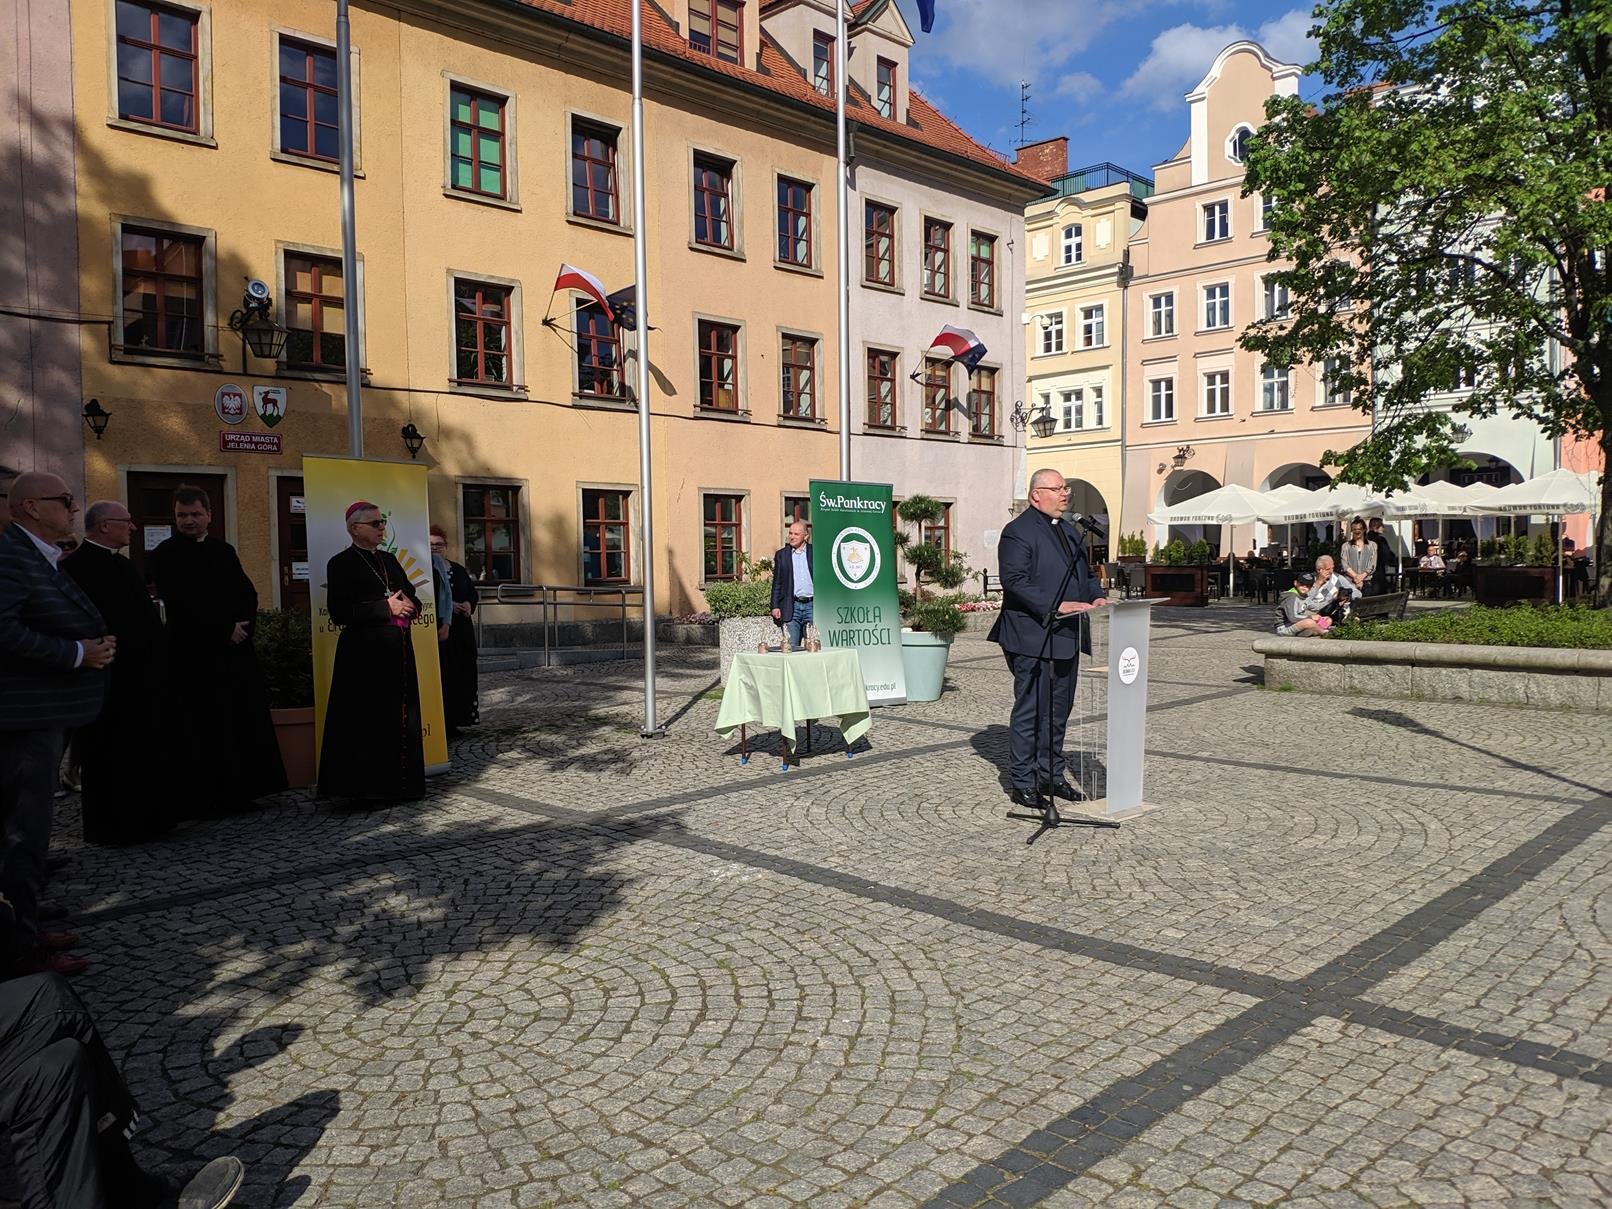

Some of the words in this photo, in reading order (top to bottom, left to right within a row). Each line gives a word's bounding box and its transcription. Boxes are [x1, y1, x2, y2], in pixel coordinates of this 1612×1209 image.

[225, 434, 250, 442] URZĄD
[252, 436, 279, 444] MIASTA
[227, 442, 256, 450] JELENIA
[836, 606, 882, 624] SZKOŁA
[828, 624, 891, 647] WARTOŚCI
